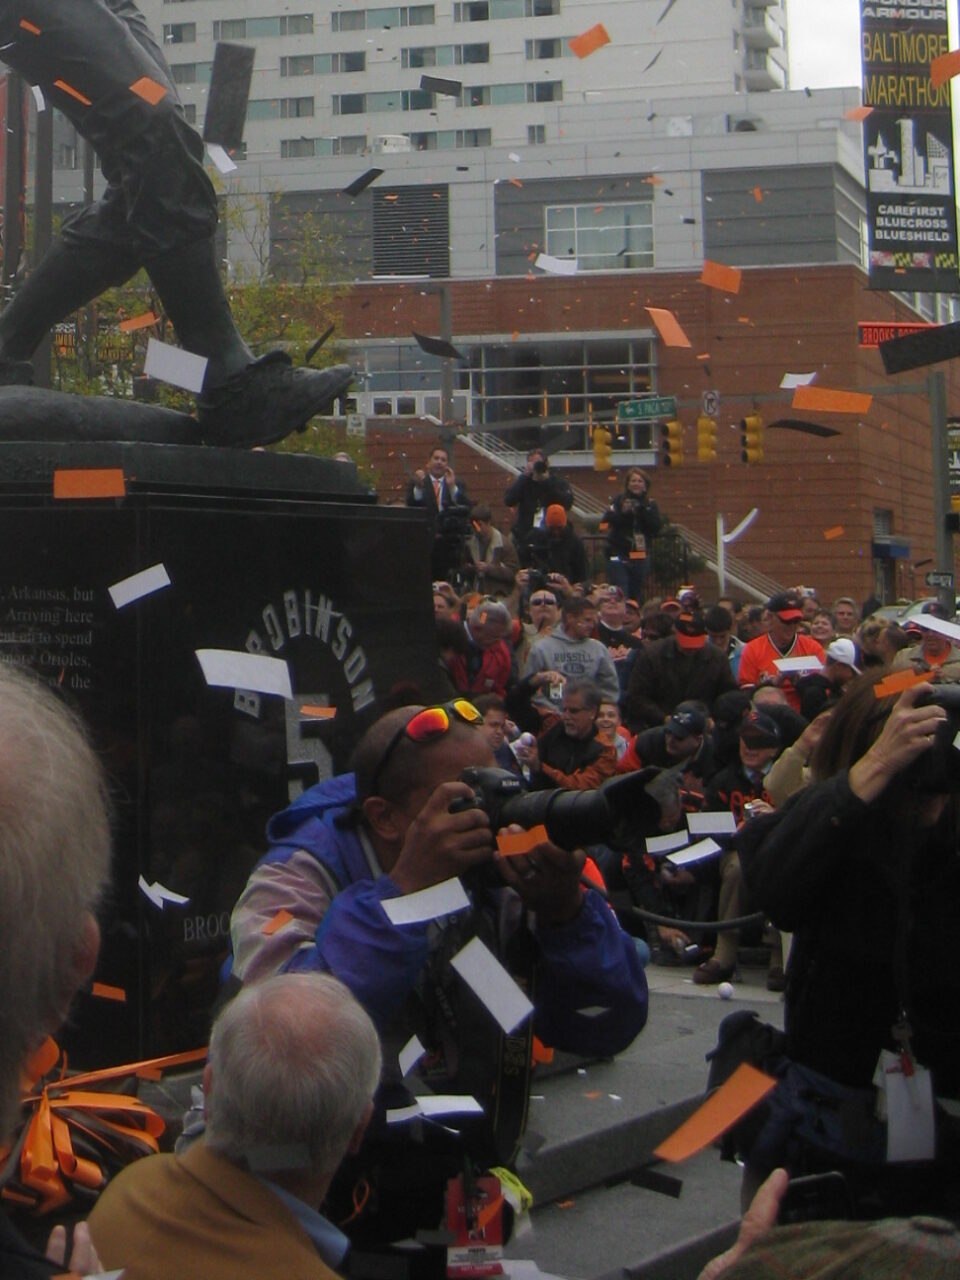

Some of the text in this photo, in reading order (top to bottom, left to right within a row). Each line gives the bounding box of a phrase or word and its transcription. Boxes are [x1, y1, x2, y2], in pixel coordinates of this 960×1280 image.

[862, 7, 947, 20] ARMOUR
[878, 204, 945, 217] CAREFIRST
[876, 217, 948, 229] BLUECROSS
[875, 229, 950, 242] BLUESHIELD
[7, 585, 69, 602] Arkansas,
[73, 586, 95, 602] but
[5, 608, 61, 626] Arriving
[64, 608, 94, 624] here
[53, 630, 93, 649] spend
[40, 651, 92, 668] Orioles,
[71, 672, 91, 689] the
[184, 911, 231, 943] BROO
